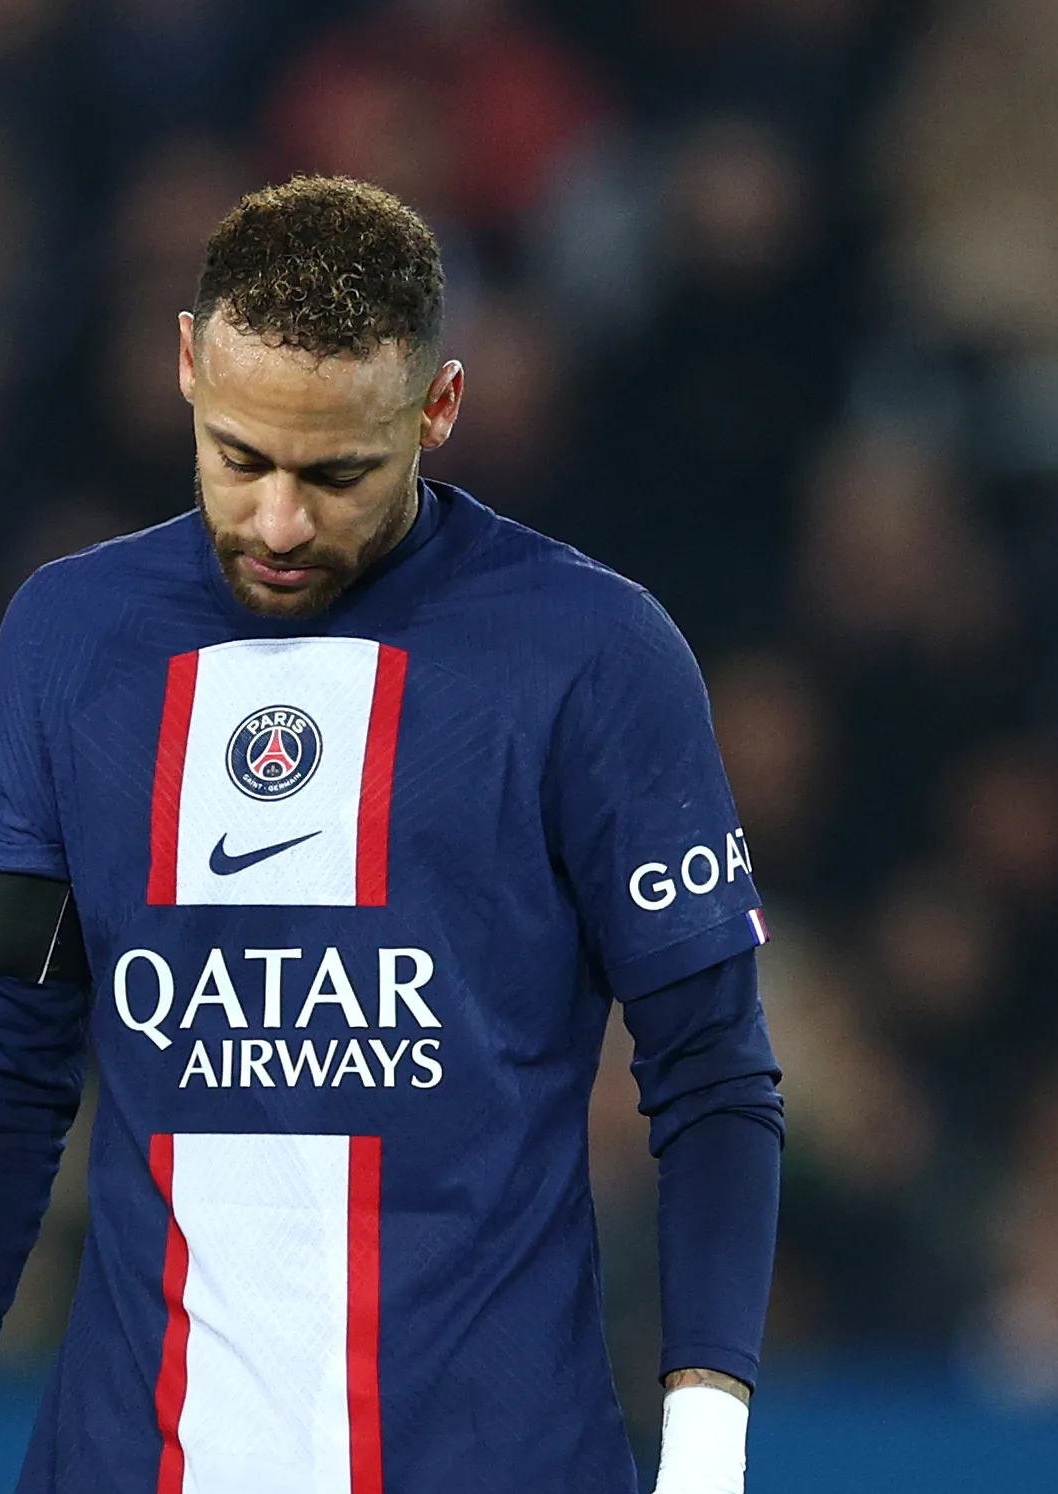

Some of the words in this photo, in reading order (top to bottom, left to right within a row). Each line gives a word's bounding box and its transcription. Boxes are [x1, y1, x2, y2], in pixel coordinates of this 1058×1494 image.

[246, 711, 307, 736] PARIS
[242, 773, 263, 790] SAINT
[267, 771, 303, 792] GERMAIN
[113, 946, 442, 1051] QATAR
[178, 1037, 443, 1089] AIRWAYS
